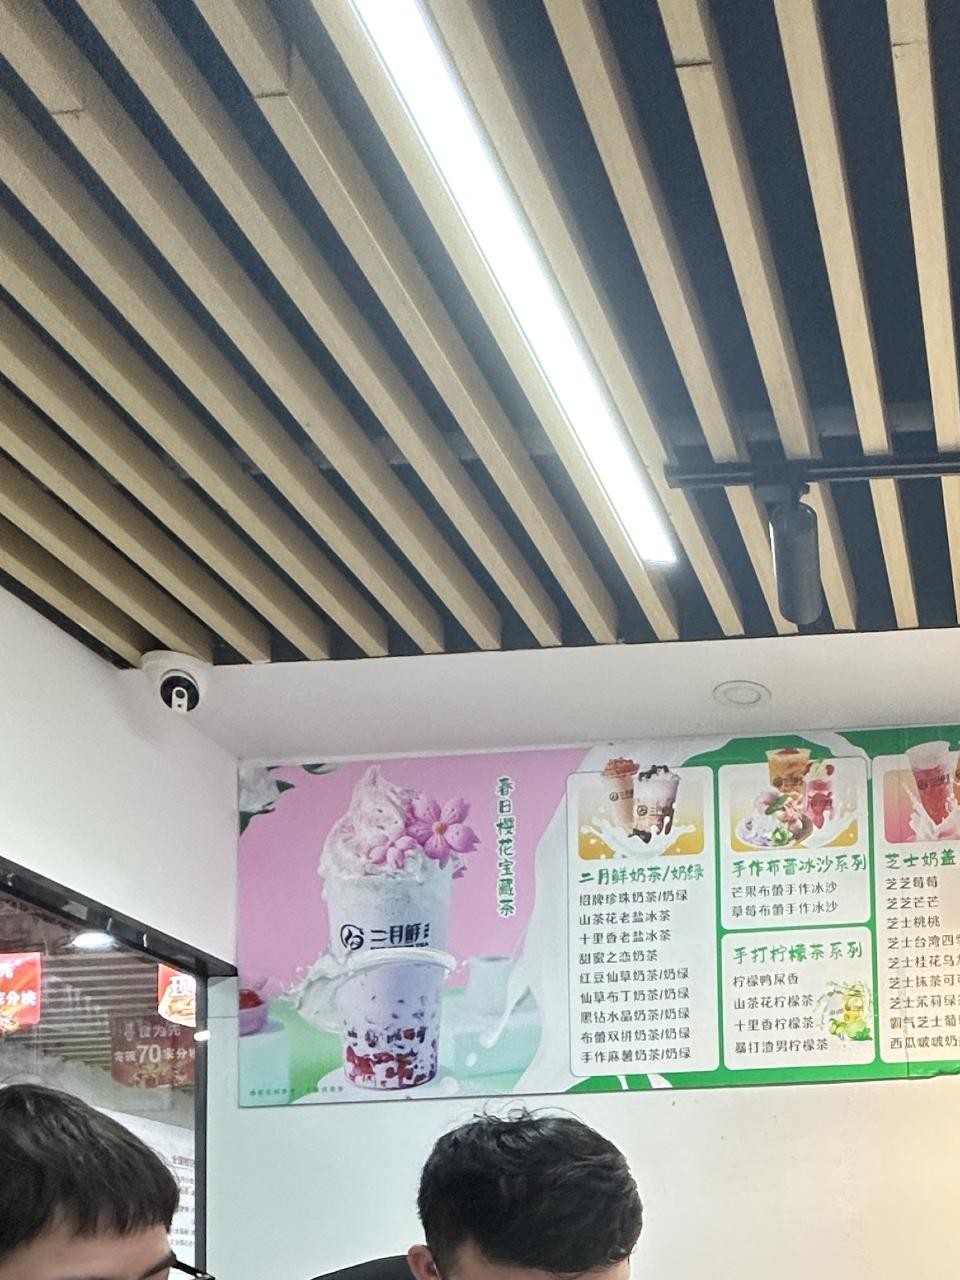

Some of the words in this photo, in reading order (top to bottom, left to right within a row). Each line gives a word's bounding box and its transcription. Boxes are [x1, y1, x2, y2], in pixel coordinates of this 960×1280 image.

[497, 777, 516, 917] 春日樱花宝藏茶
[579, 864, 704, 885] 二月鲜奶茶/奶绿
[579, 890, 688, 906] 招牌珍珠奶茶/奶绿
[731, 882, 837, 898] 芒果布蕾手作冰沙
[732, 901, 838, 917] 草莓布蕾手作冰沙
[886, 896, 939, 910] 芝芝芒芒
[579, 910, 671, 926] 山茶花老盐冰茶
[887, 916, 940, 929] 芝士桃桃
[580, 930, 671, 945] 十里香老盐冰茶
[579, 950, 658, 965] 甜蜜之恋奶茶
[733, 941, 862, 964] 手打柠檬茶系列
[580, 967, 689, 984] 红豆仙草奶茶/奶绿
[733, 973, 799, 987] 柠檬鸭屎香
[581, 987, 689, 1004] 仙草布丁奶茶/奶绿
[734, 995, 813, 1010] 山茶花柠檬茶
[581, 1007, 690, 1024] 黑钻水晶奶茶/奶绿
[735, 1017, 814, 1032] 十里香柠檬茶
[581, 1027, 690, 1044] 布蕾双拼奶茶/奶绿
[735, 1038, 828, 1054] 暴打渣男柠檬茶
[581, 1047, 690, 1063] 手作麻薯奶茶/奶绿
